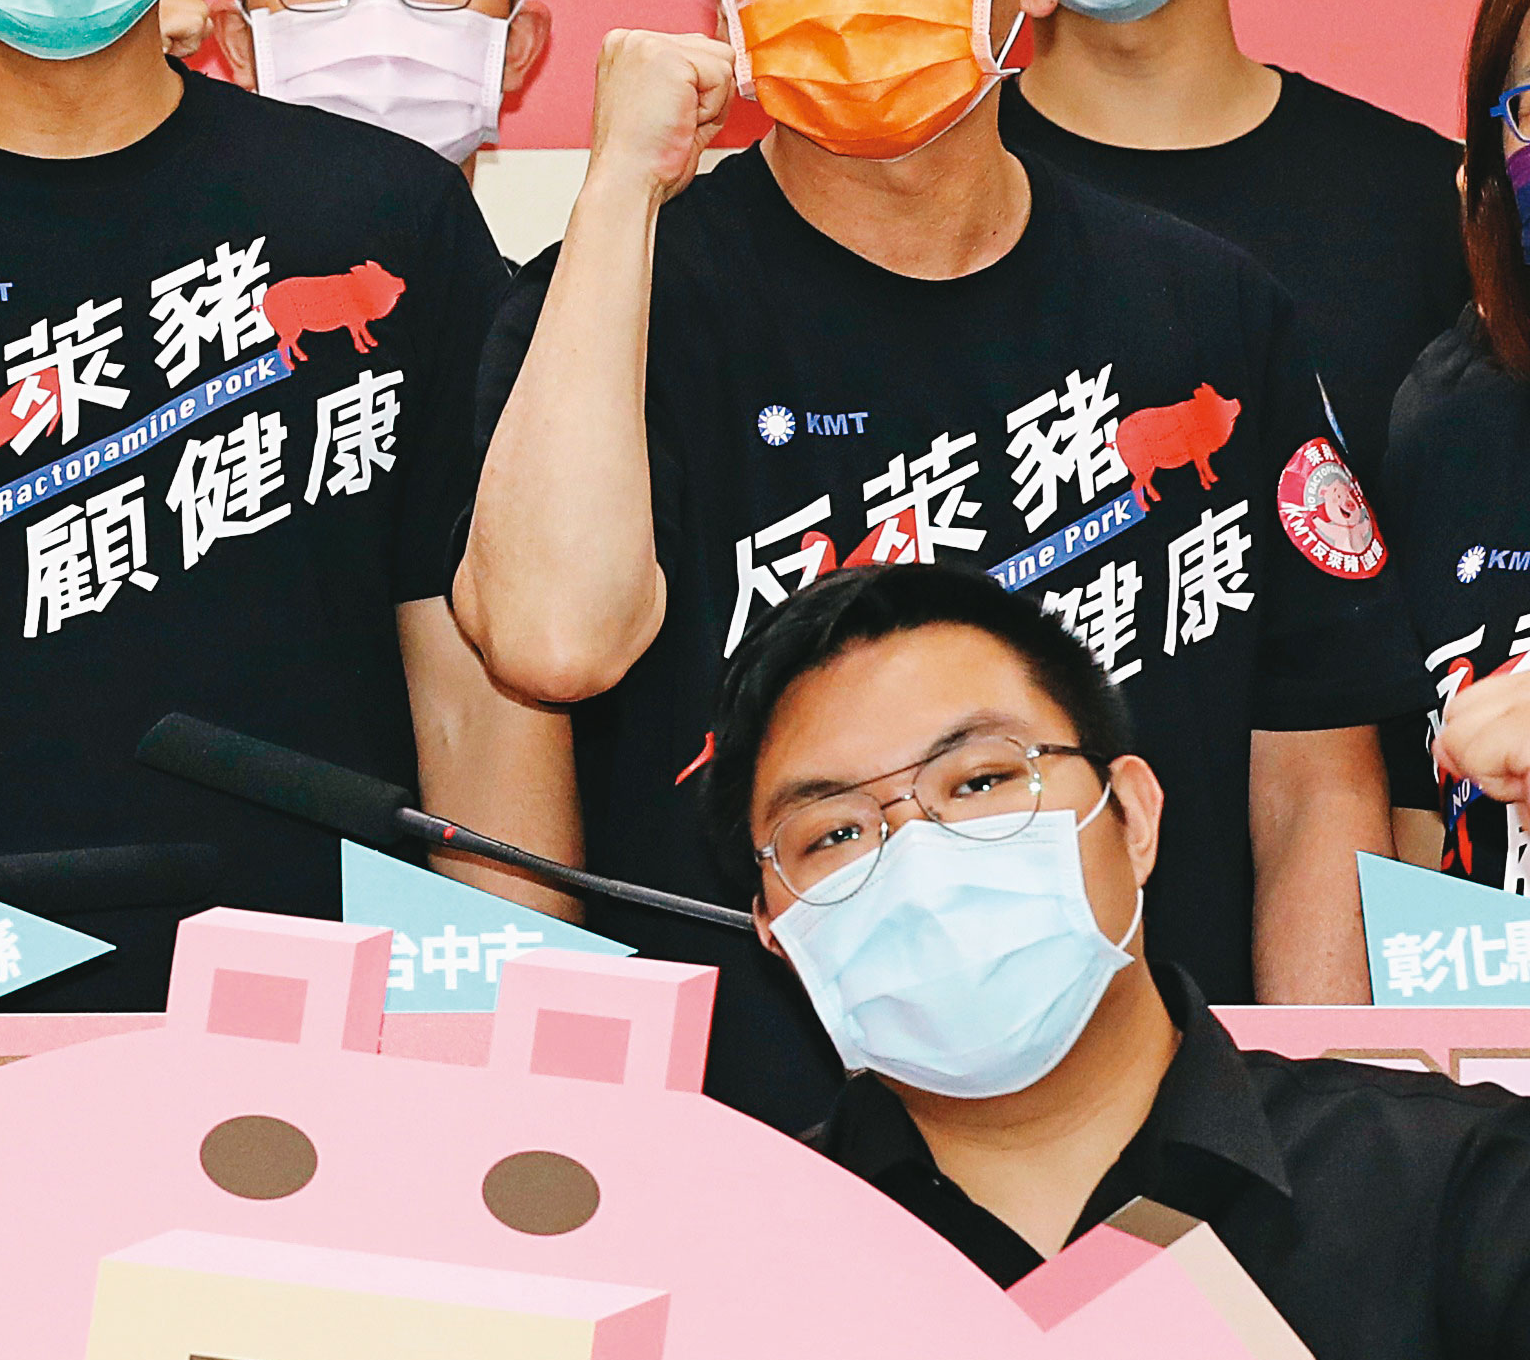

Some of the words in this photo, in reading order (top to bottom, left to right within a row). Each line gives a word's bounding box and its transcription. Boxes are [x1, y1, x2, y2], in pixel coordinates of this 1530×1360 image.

[204, 353, 278, 406] Pork
[806, 409, 870, 437] KMT
[24, 369, 405, 640] 顧健康
[1064, 498, 1134, 554] Pork
